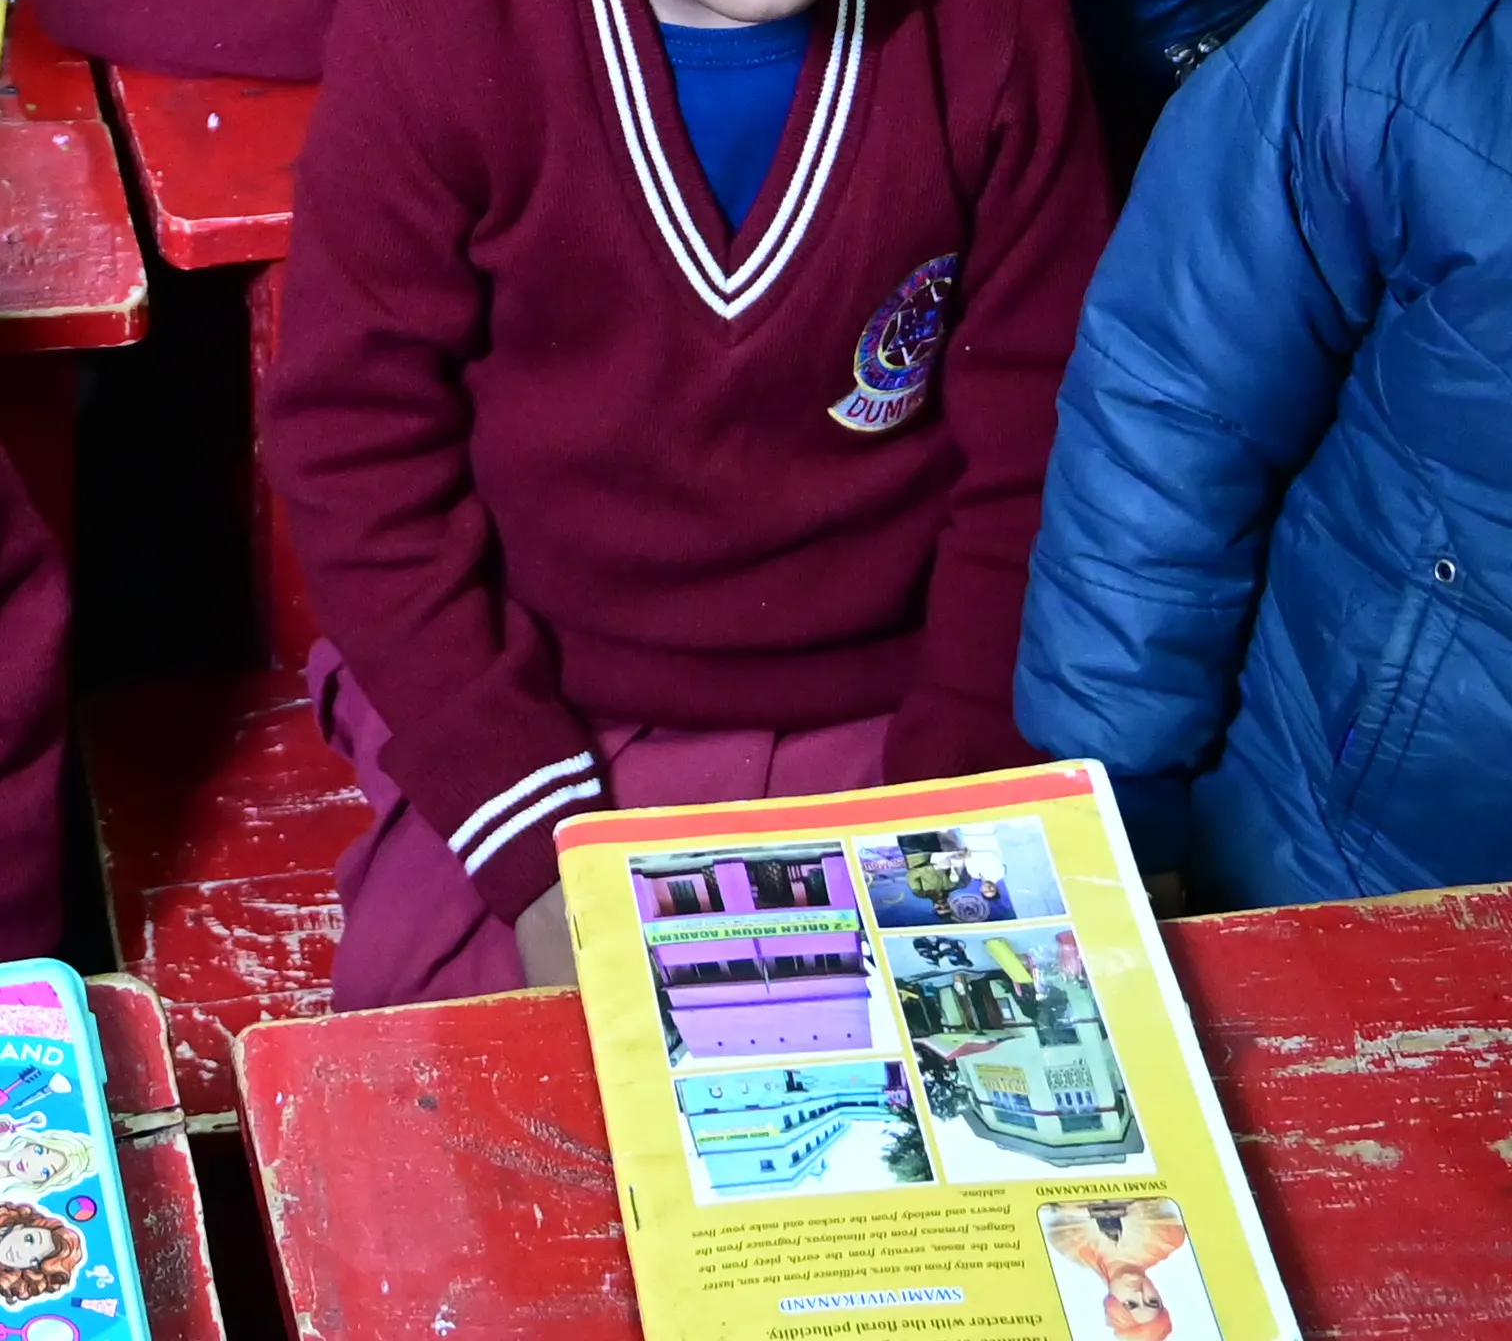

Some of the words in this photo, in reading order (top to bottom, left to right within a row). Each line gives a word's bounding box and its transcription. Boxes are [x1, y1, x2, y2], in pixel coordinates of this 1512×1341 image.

[723, 927, 776, 937] MOUNT
[780, 923, 829, 933] GREEN
[650, 930, 719, 942] ACADEMY
[959, 1187, 1005, 1198] sublime.
[1035, 1182, 1120, 1196] VIVEKANAND
[1122, 1180, 1167, 1195] SWAMI
[945, 1207, 966, 1218] and
[970, 1204, 1010, 1215] flowers
[849, 1215, 867, 1225] the
[871, 1211, 897, 1223] from
[901, 1210, 941, 1222] melody
[720, 1223, 745, 1235] your
[749, 1221, 778, 1232] make
[782, 1220, 804, 1230] and
[920, 1223, 969, 1236] firmness
[972, 1221, 1015, 1234] Ganges,
[691, 1229, 716, 1239] lives
[804, 1231, 866, 1244] Himalayas,
[870, 1231, 887, 1241] the
[890, 1227, 917, 1238] from
[716, 1241, 742, 1252] from
[746, 1236, 800, 1249] fragrance
[970, 1243, 988, 1252] the
[994, 1240, 1020, 1250] from
[695, 1246, 712, 1256] the
[825, 1252, 843, 1261] the
[848, 1248, 875, 1258] from
[880, 1245, 925, 1258] serenity
[721, 1259, 748, 1269] from
[753, 1254, 781, 1267] piety
[786, 1253, 820, 1264] earth,
[698, 1264, 716, 1274] the
[903, 1264, 921, 1273] the
[924, 1260, 951, 1272] from
[986, 1260, 1024, 1270] Imbibe
[783, 1270, 810, 1282] from
[813, 1267, 867, 1279] brilliance
[763, 1275, 780, 1284] the
[701, 1280, 734, 1291] luster
[901, 1287, 962, 1302] SWAMI
[780, 1292, 896, 1310] VIVEKANAND
[901, 1318, 926, 1331] the
[930, 1317, 964, 1329] with
[969, 1314, 1042, 1329] character
[766, 1320, 850, 1339] pellucidity.
[856, 1320, 897, 1335] floral
